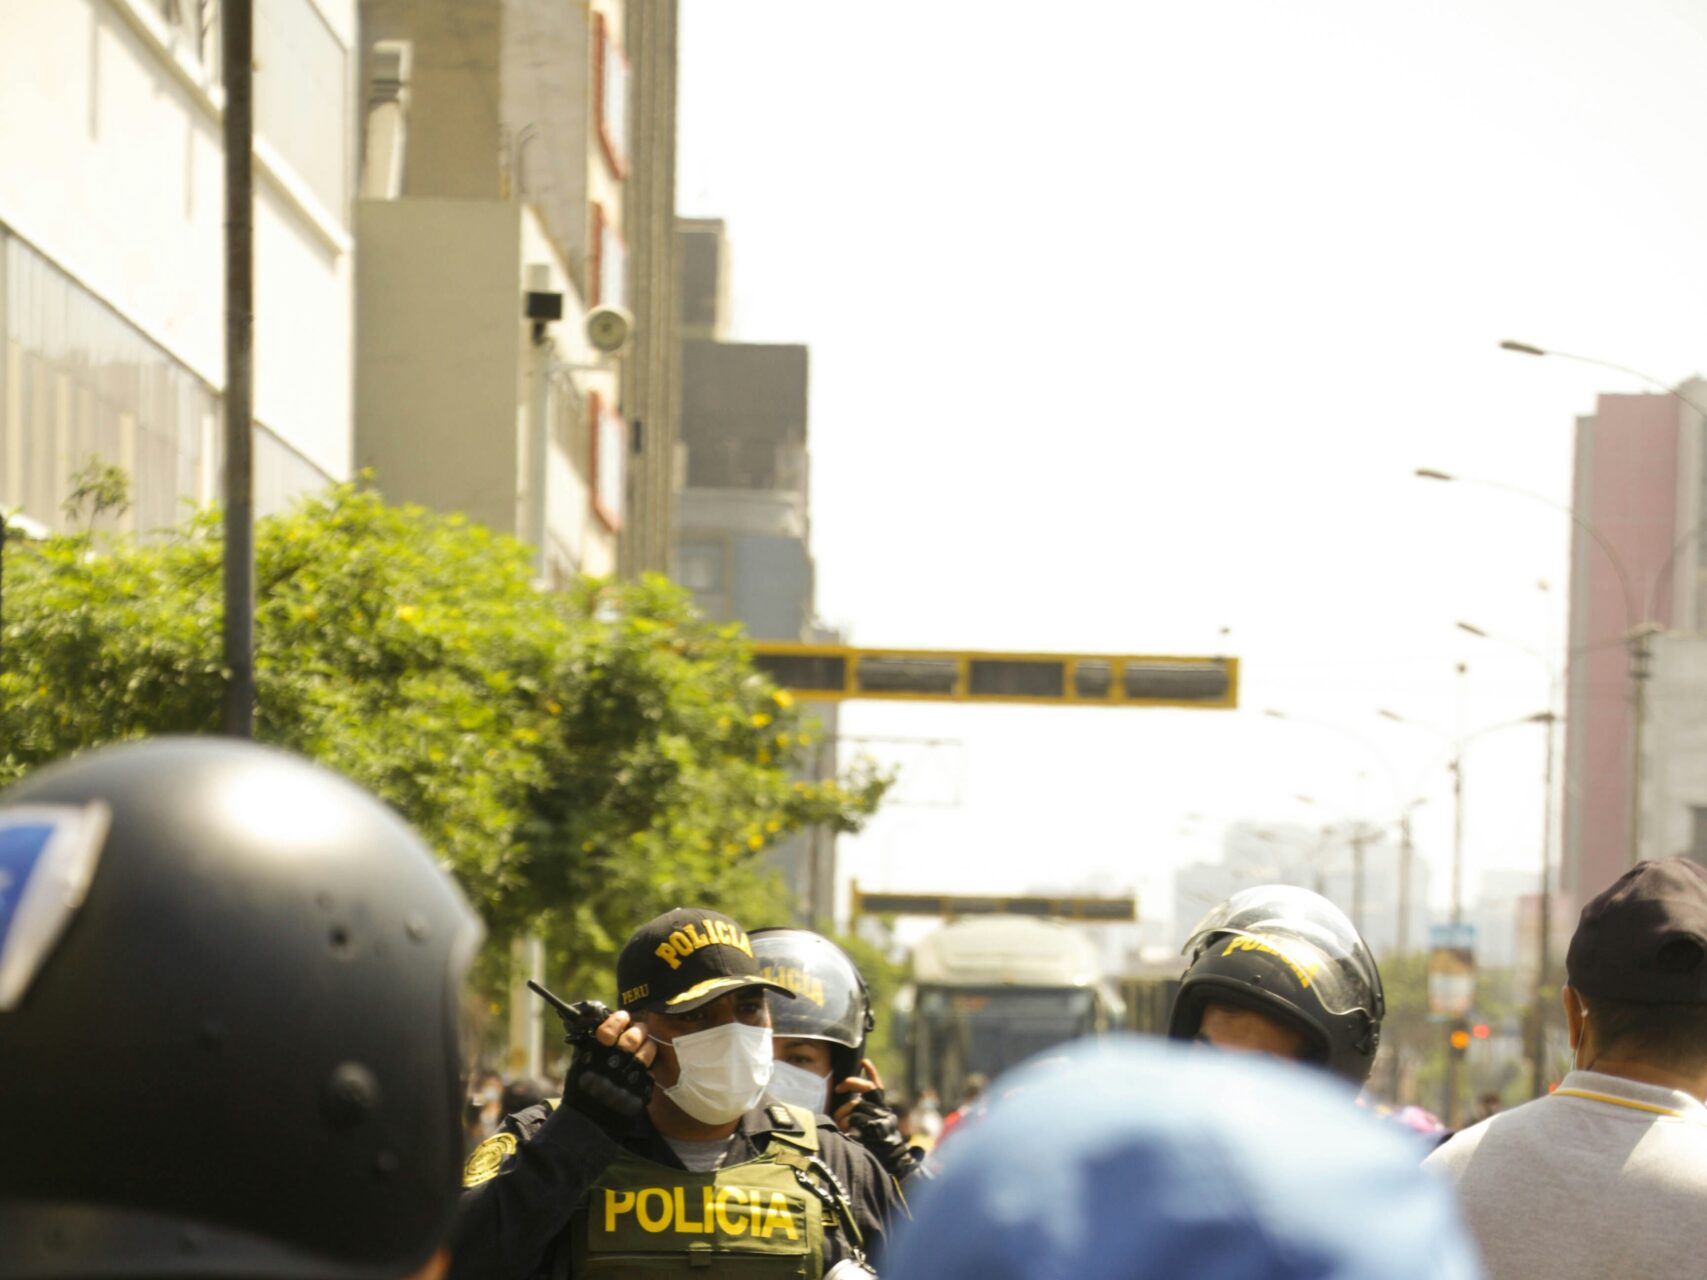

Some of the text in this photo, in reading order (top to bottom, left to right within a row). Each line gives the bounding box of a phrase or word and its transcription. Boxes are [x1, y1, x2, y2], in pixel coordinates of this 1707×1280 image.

[655, 919, 753, 970] POLICIA
[621, 984, 649, 1005] PERU
[604, 1186, 799, 1241] POLICIA
